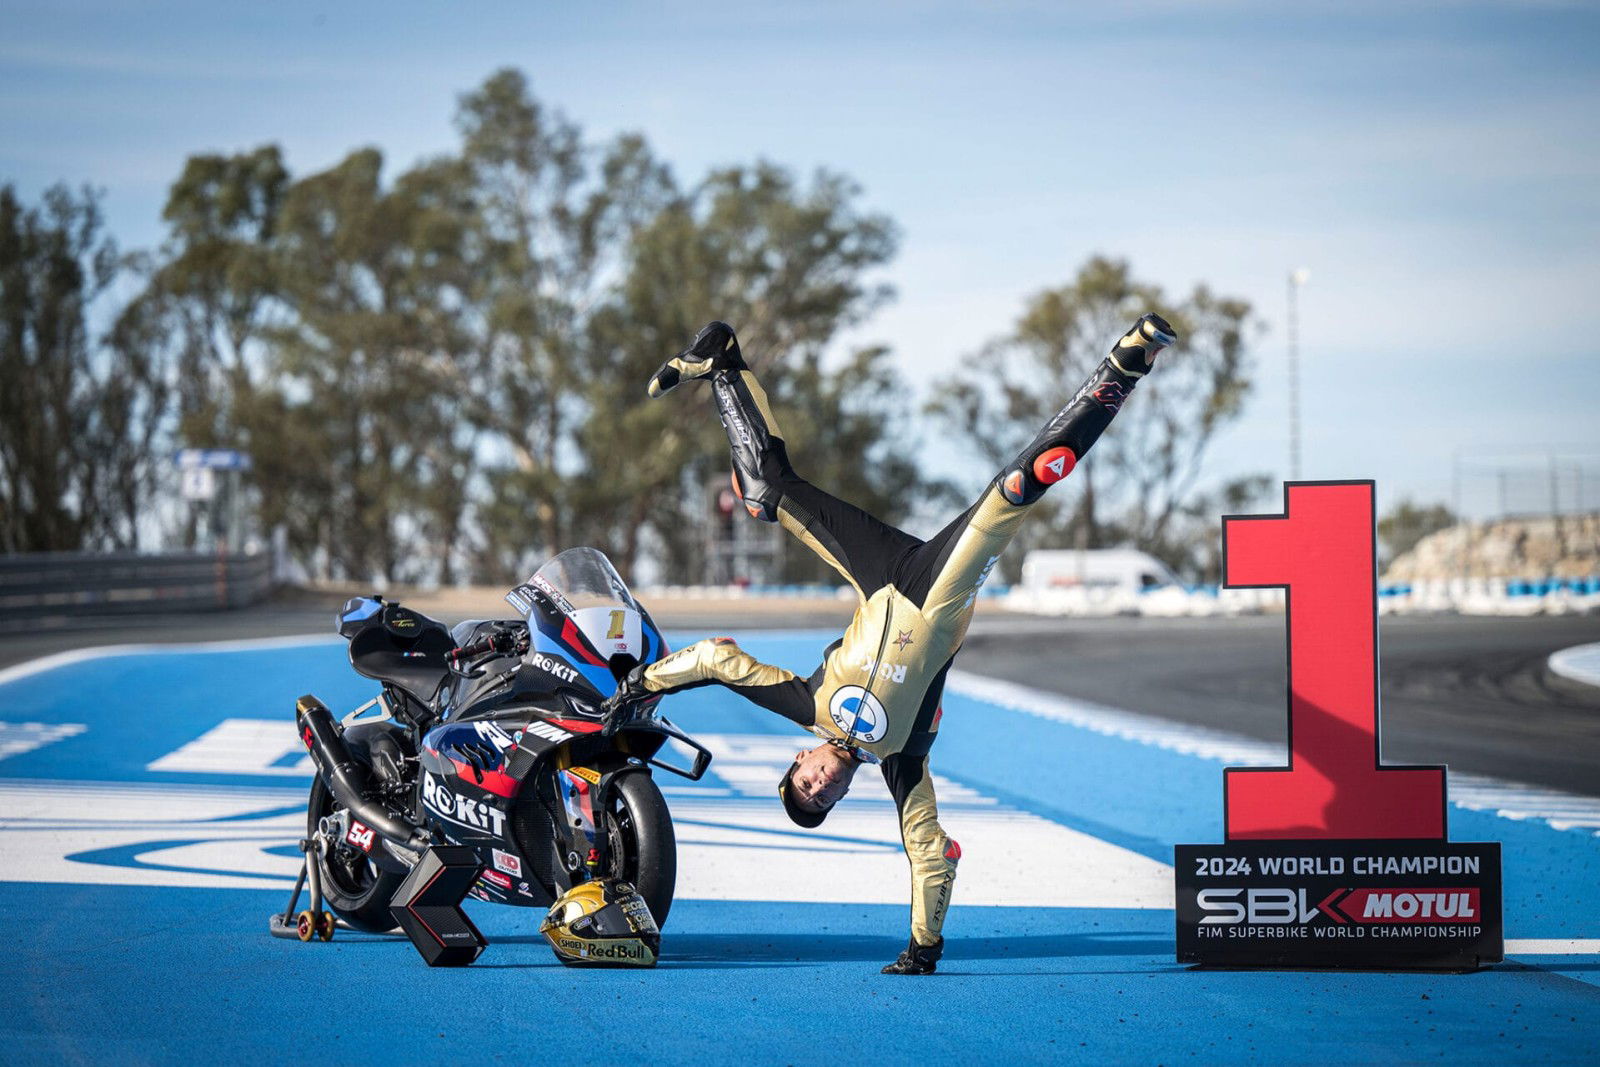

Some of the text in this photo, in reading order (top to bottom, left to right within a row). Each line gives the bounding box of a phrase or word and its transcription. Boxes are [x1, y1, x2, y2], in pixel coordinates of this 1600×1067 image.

[607, 609, 626, 640] 1
[1221, 480, 1447, 843] 1
[350, 820, 374, 850] 54
[1195, 856, 1481, 876] 2024 WORLD CHAMPION
[1196, 888, 1475, 924] SBK MOTUL
[1197, 926, 1482, 938] FIM SUPERBIKE WORLD CHAMPIONSHIP
[587, 943, 645, 959] Red Bull
